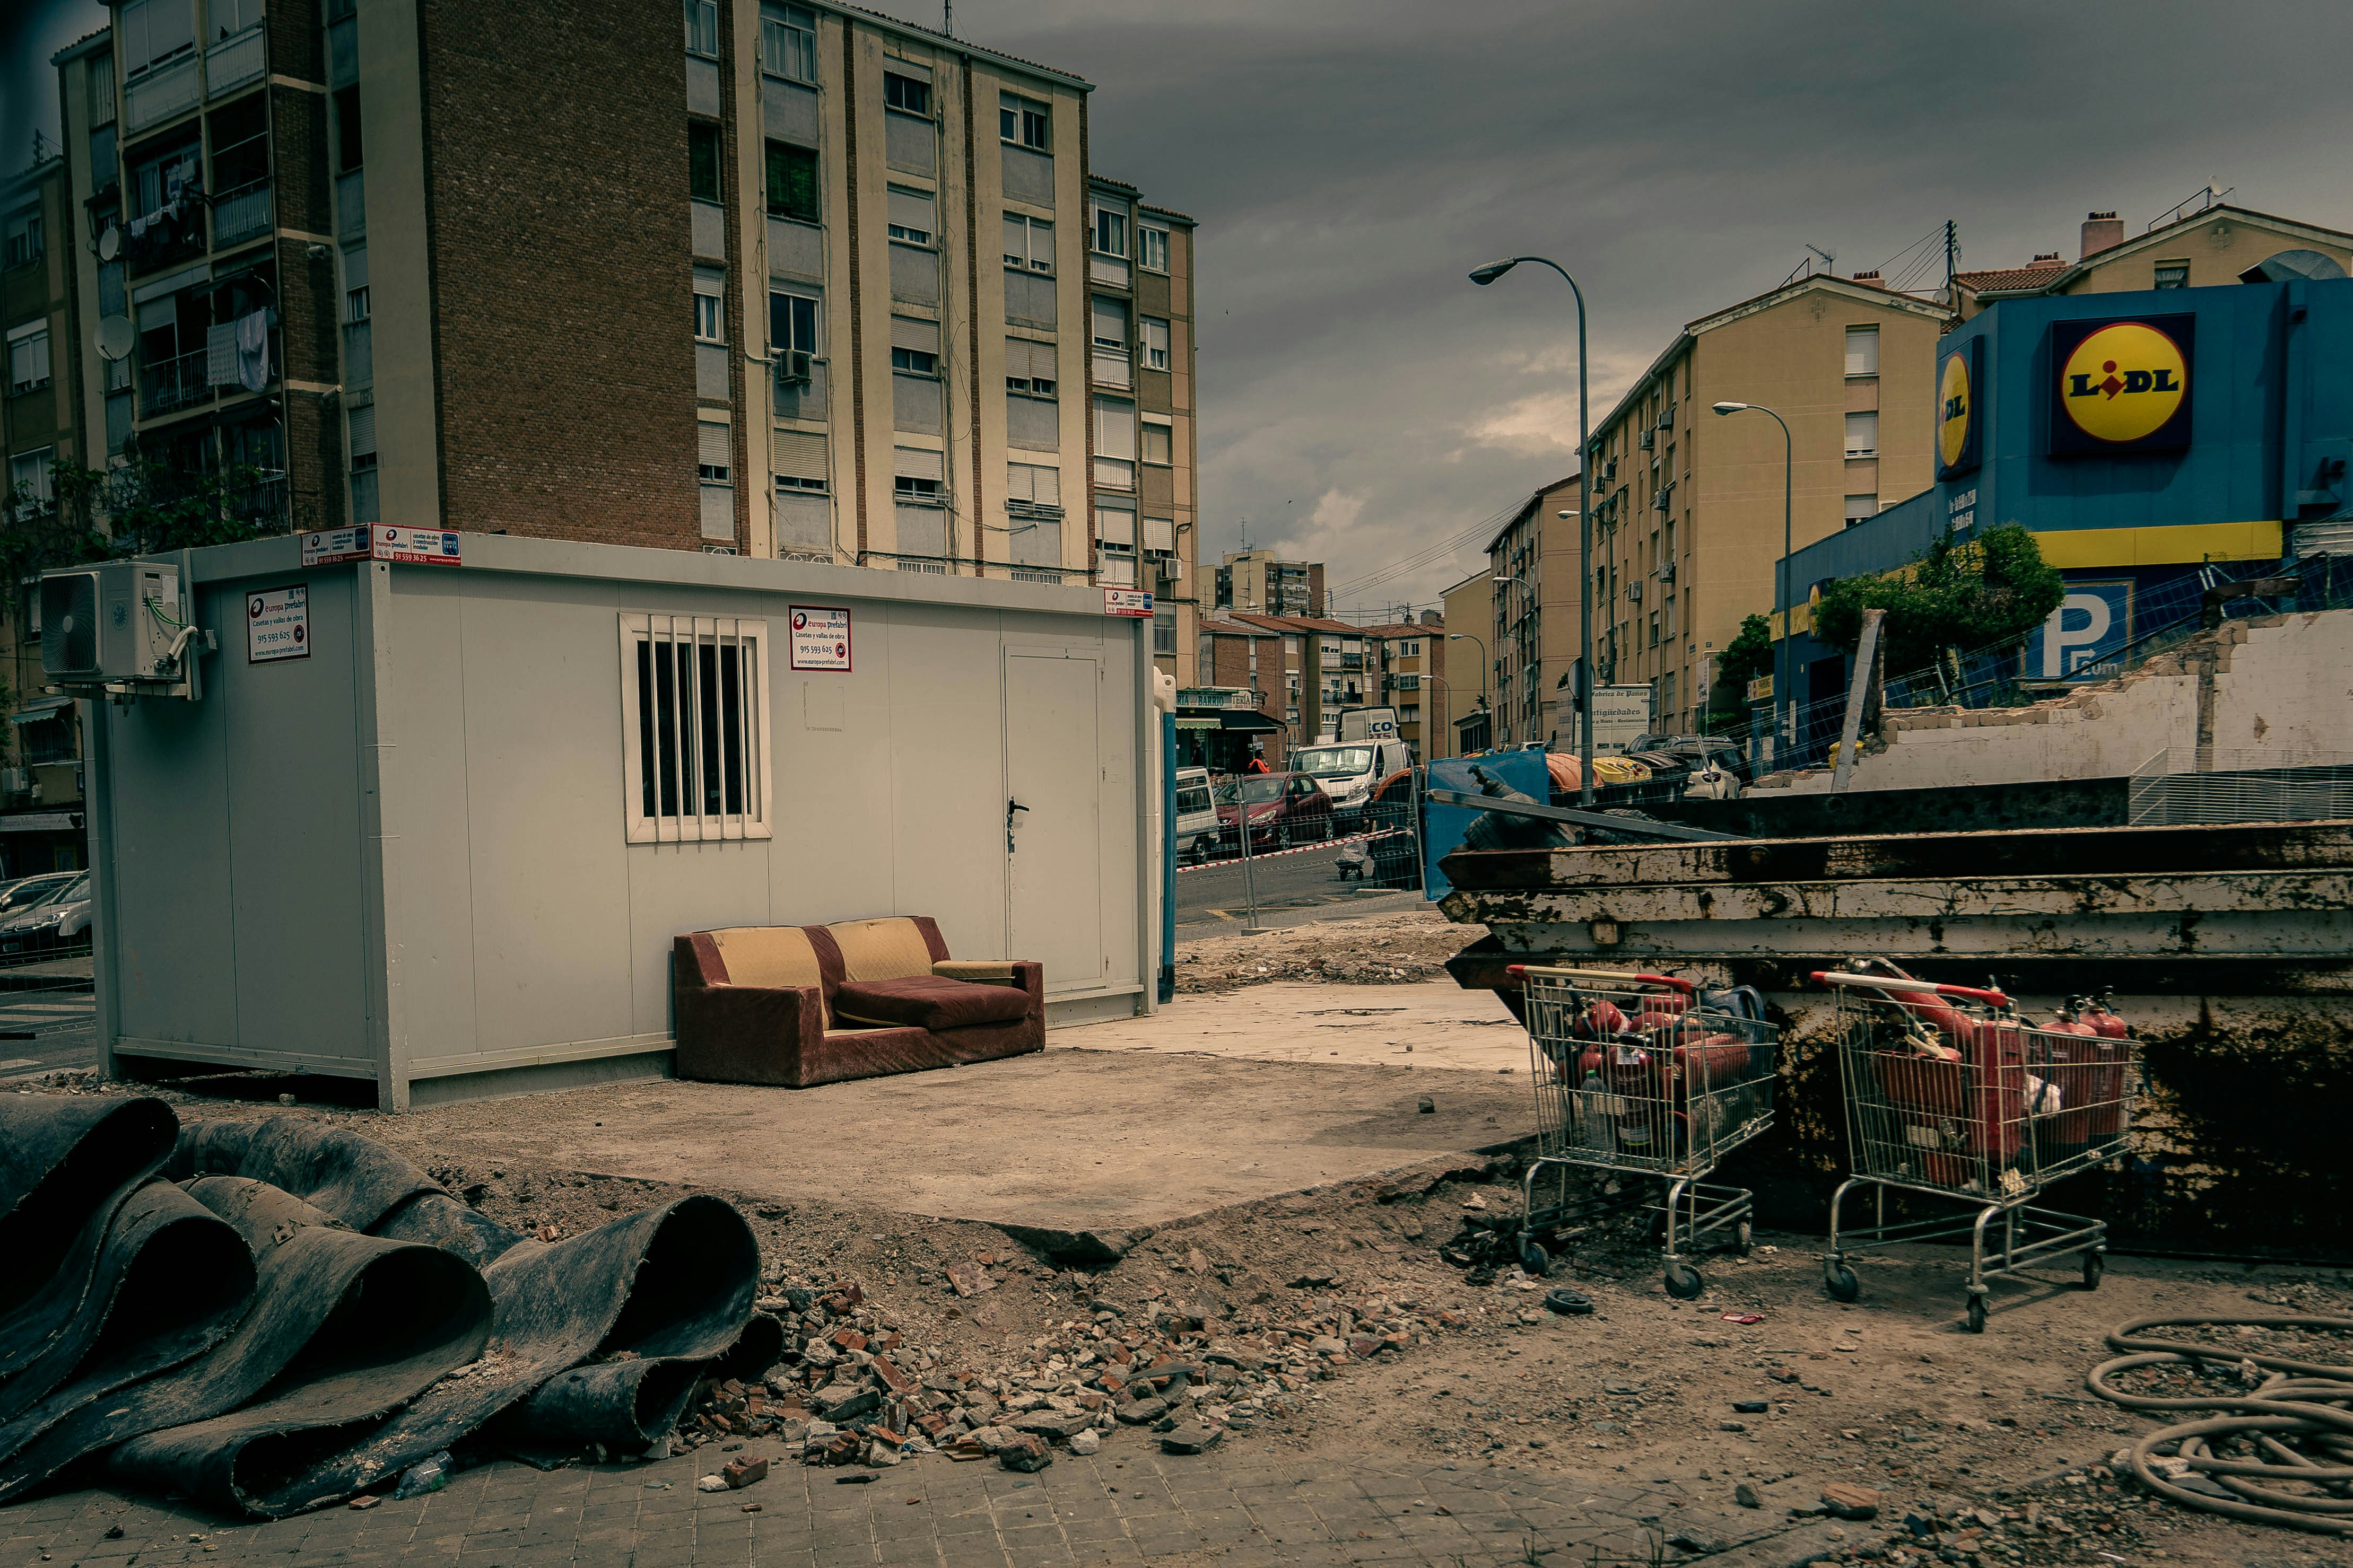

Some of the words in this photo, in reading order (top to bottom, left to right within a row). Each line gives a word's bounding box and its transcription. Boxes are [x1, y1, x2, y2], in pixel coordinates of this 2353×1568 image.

[265, 604, 284, 614] europa
[284, 599, 306, 612] prefabri
[808, 621, 827, 629] europa
[827, 621, 847, 630] prefabri
[257, 634, 267, 644] 915
[268, 633, 278, 643] 593
[280, 630, 290, 641] 625
[2043, 594, 2111, 677] P
[800, 645, 809, 654] 915
[811, 646, 821, 654] 593
[822, 645, 832, 654] 625
[1198, 696, 1224, 707] BARRIO
